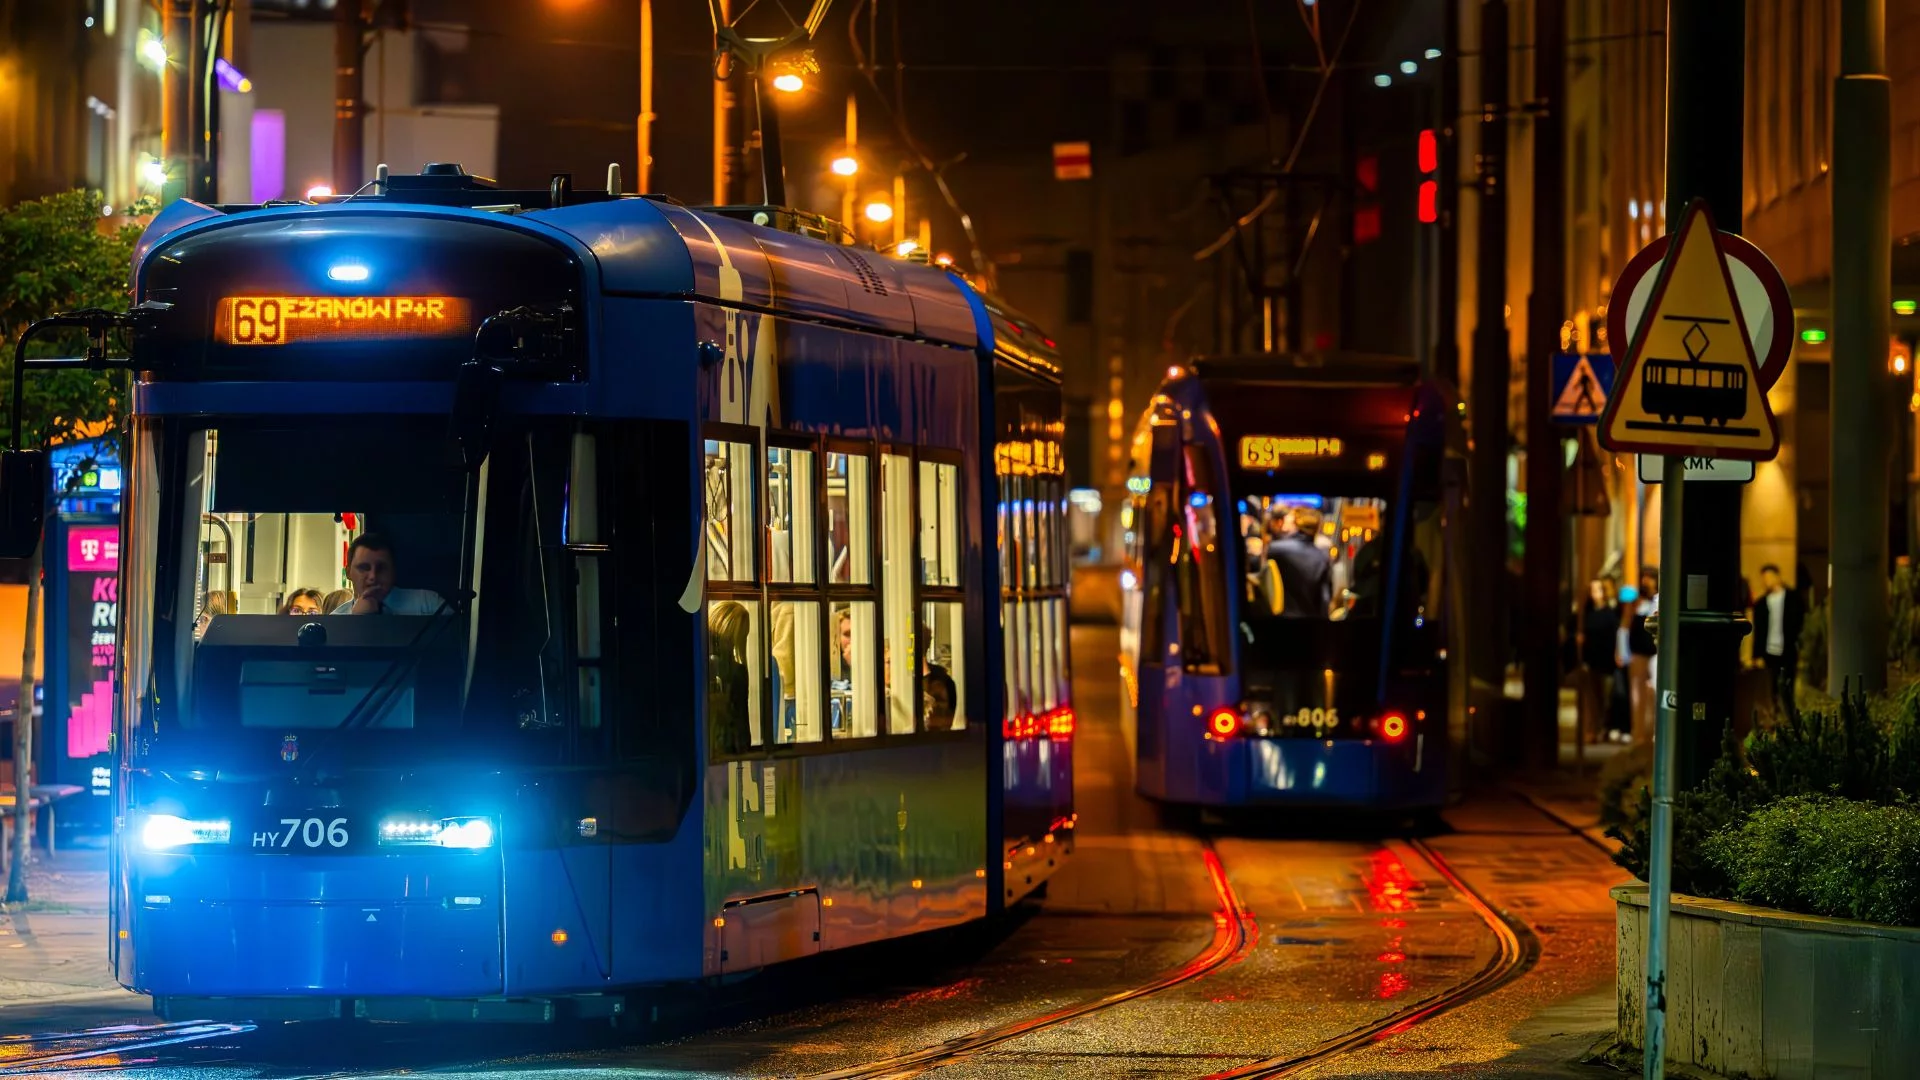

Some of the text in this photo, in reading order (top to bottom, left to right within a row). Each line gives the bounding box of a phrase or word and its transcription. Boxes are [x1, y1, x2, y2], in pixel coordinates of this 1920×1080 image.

[234, 299, 282, 343] 69
[397, 299, 444, 318] P+R
[1247, 440, 1276, 463] 69
[81, 539, 99, 561] T
